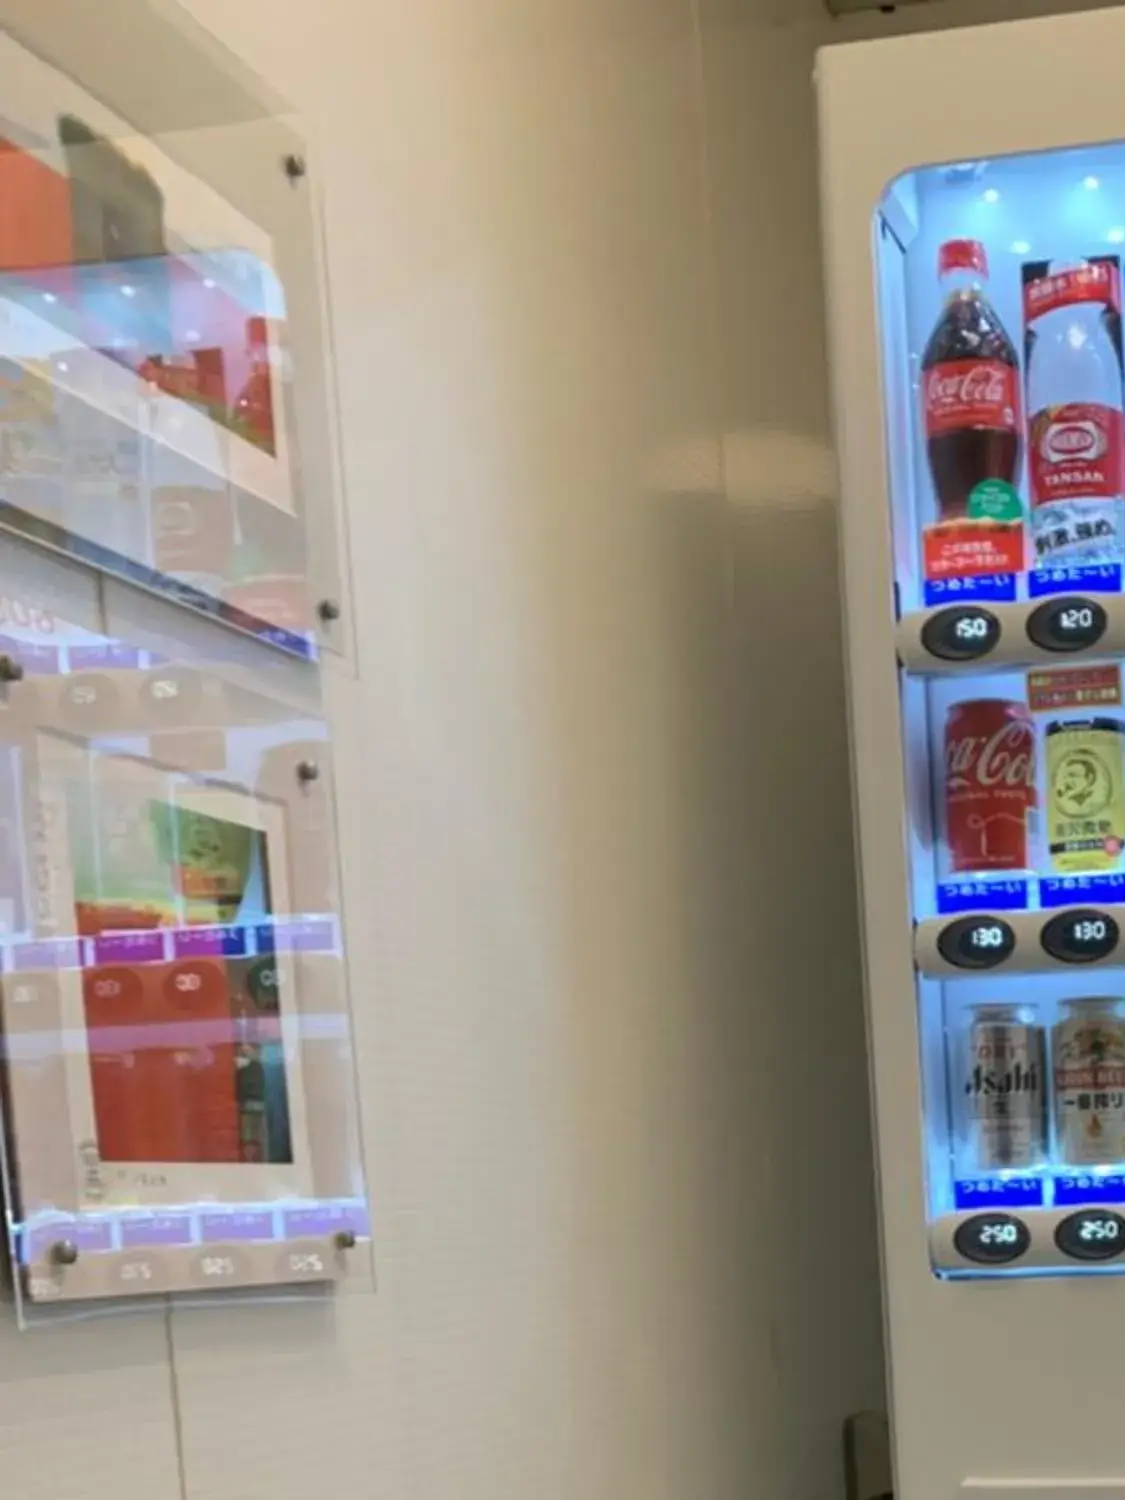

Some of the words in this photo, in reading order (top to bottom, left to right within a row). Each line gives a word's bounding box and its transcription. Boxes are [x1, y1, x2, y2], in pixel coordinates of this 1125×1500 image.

[1043, 472, 1104, 487] TANSAN
[955, 617, 988, 638] 150
[1061, 609, 1094, 628] 120
[971, 927, 1003, 947] 130
[1074, 921, 1106, 940] 130
[965, 1061, 1037, 1096] Asahi
[980, 1225, 1017, 1244] 250
[1080, 1220, 1118, 1241] 250
